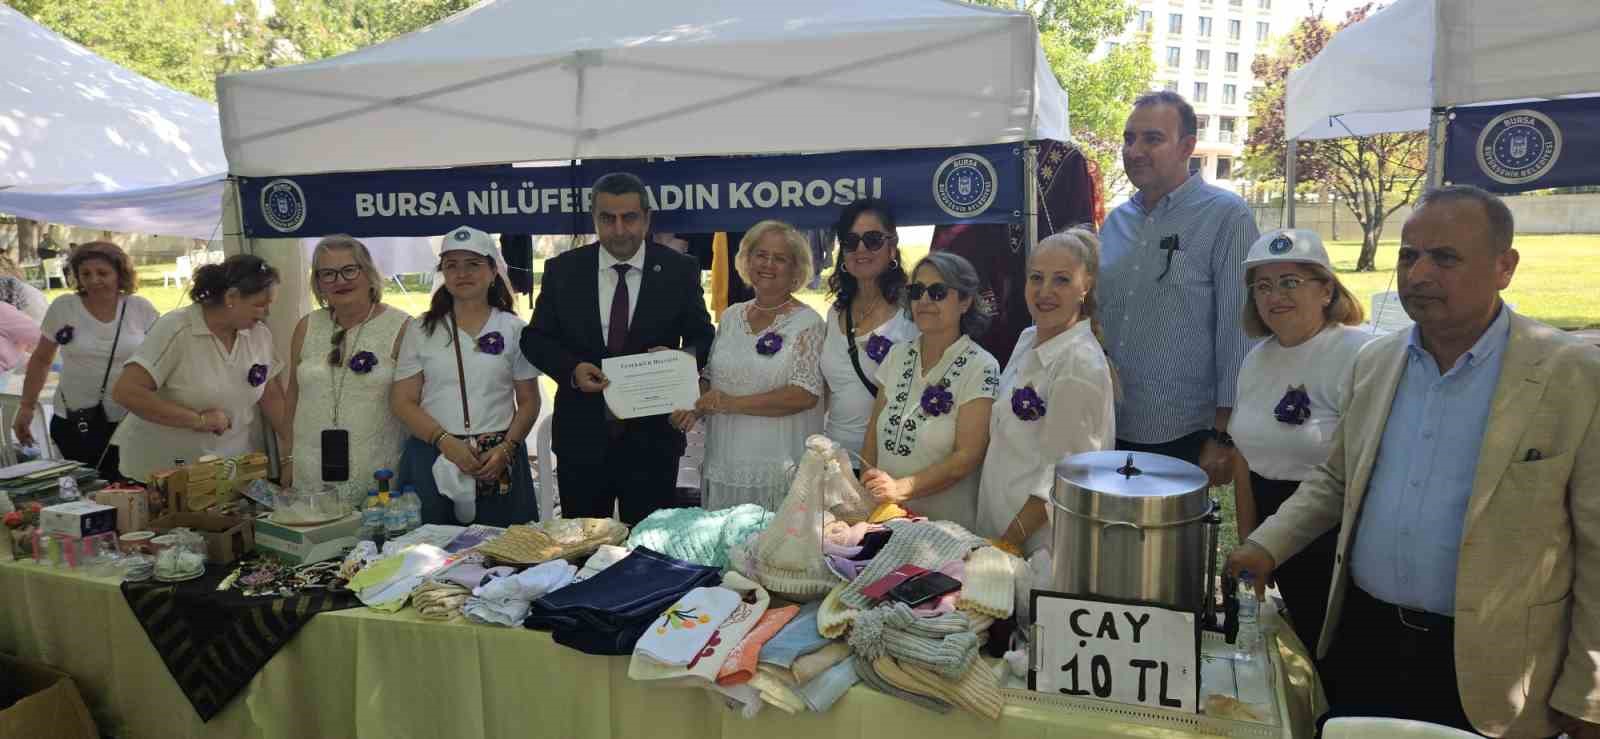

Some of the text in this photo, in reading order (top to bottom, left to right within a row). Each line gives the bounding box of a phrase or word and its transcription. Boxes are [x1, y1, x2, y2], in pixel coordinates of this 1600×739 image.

[355, 191, 462, 217] BURSA
[642, 183, 720, 212] ADIN
[1069, 608, 1151, 648] ÇAY
[1059, 653, 1182, 708] 10 TL
